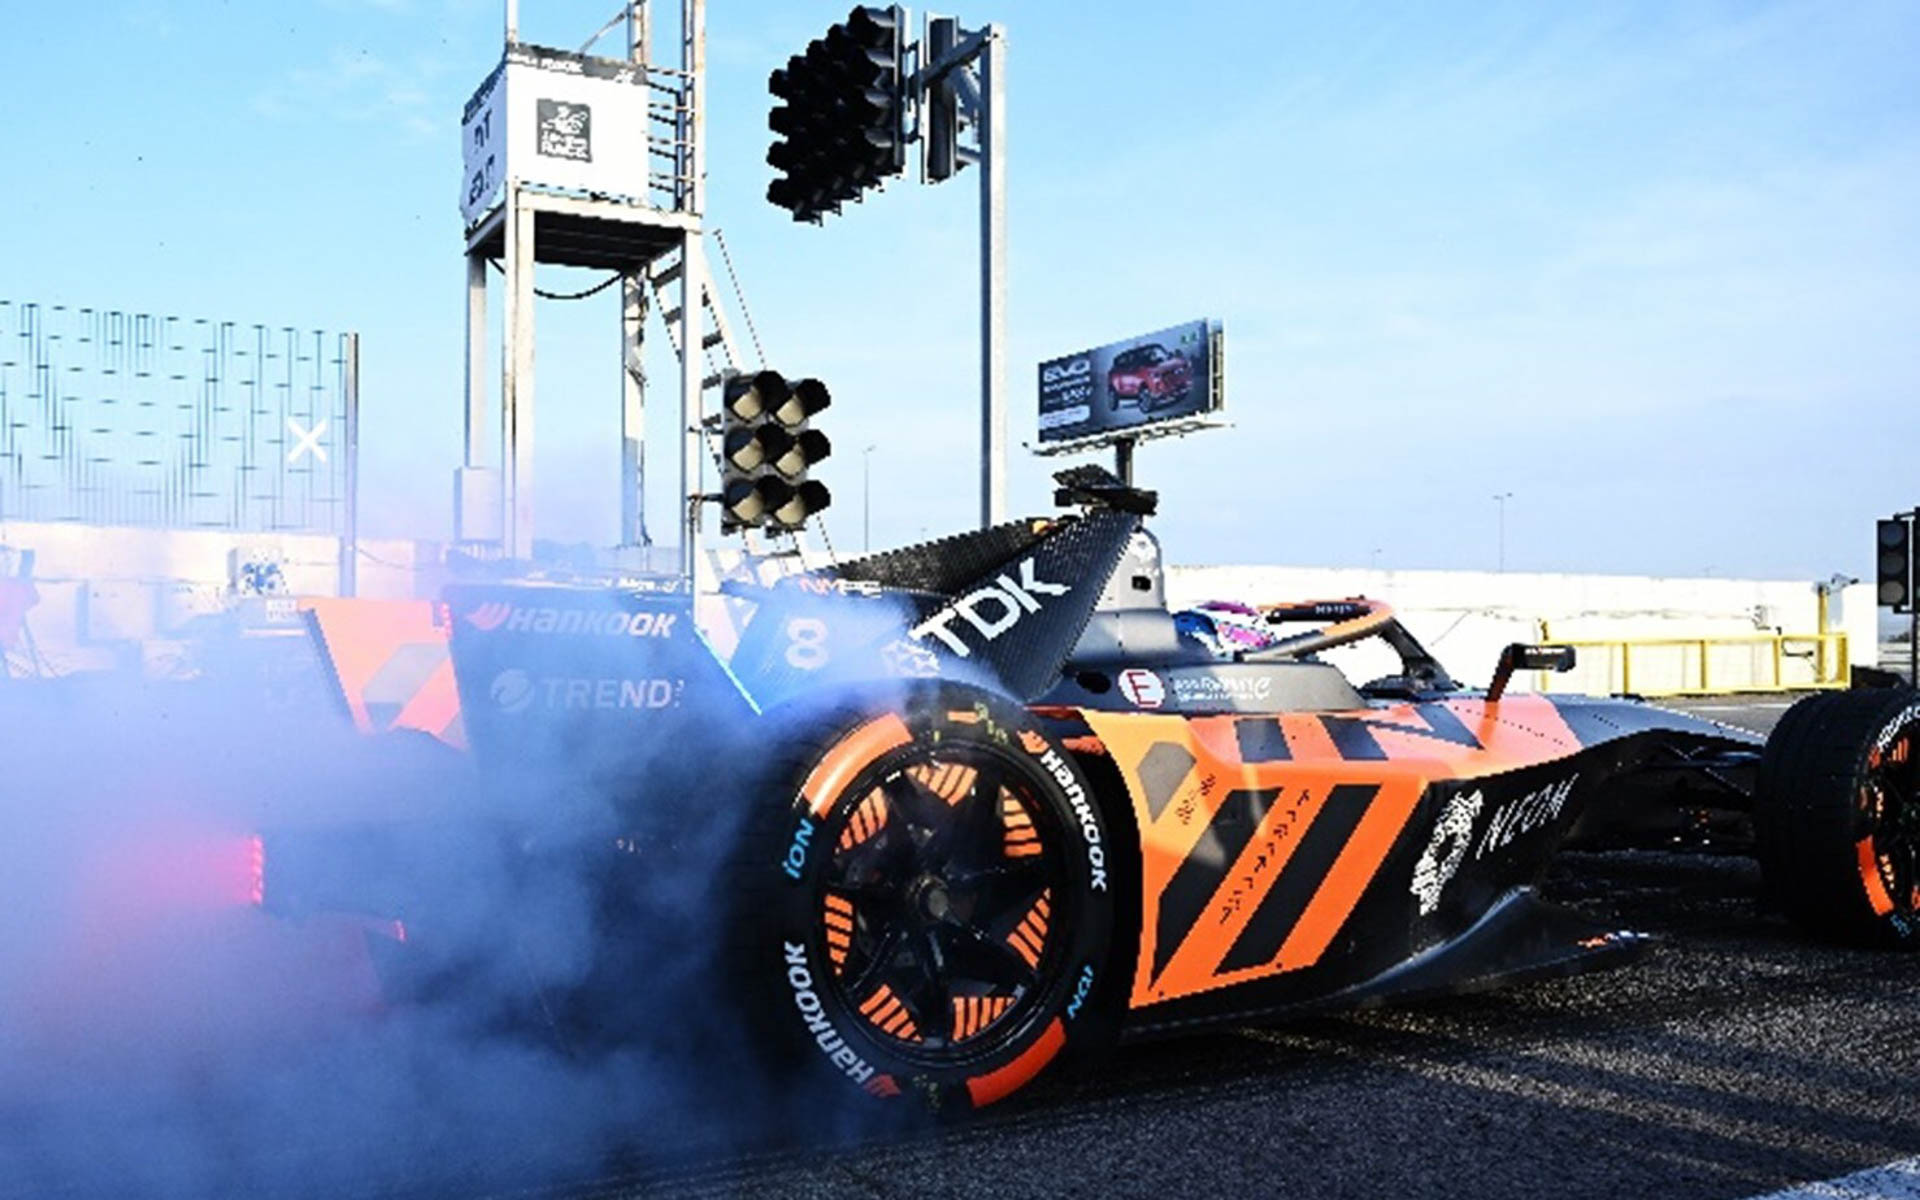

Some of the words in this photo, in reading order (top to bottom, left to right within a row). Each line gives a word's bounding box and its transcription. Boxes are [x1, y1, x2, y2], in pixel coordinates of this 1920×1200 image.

[908, 556, 1072, 658] TDK
[786, 618, 829, 670] 8
[540, 678, 672, 709] TREND
